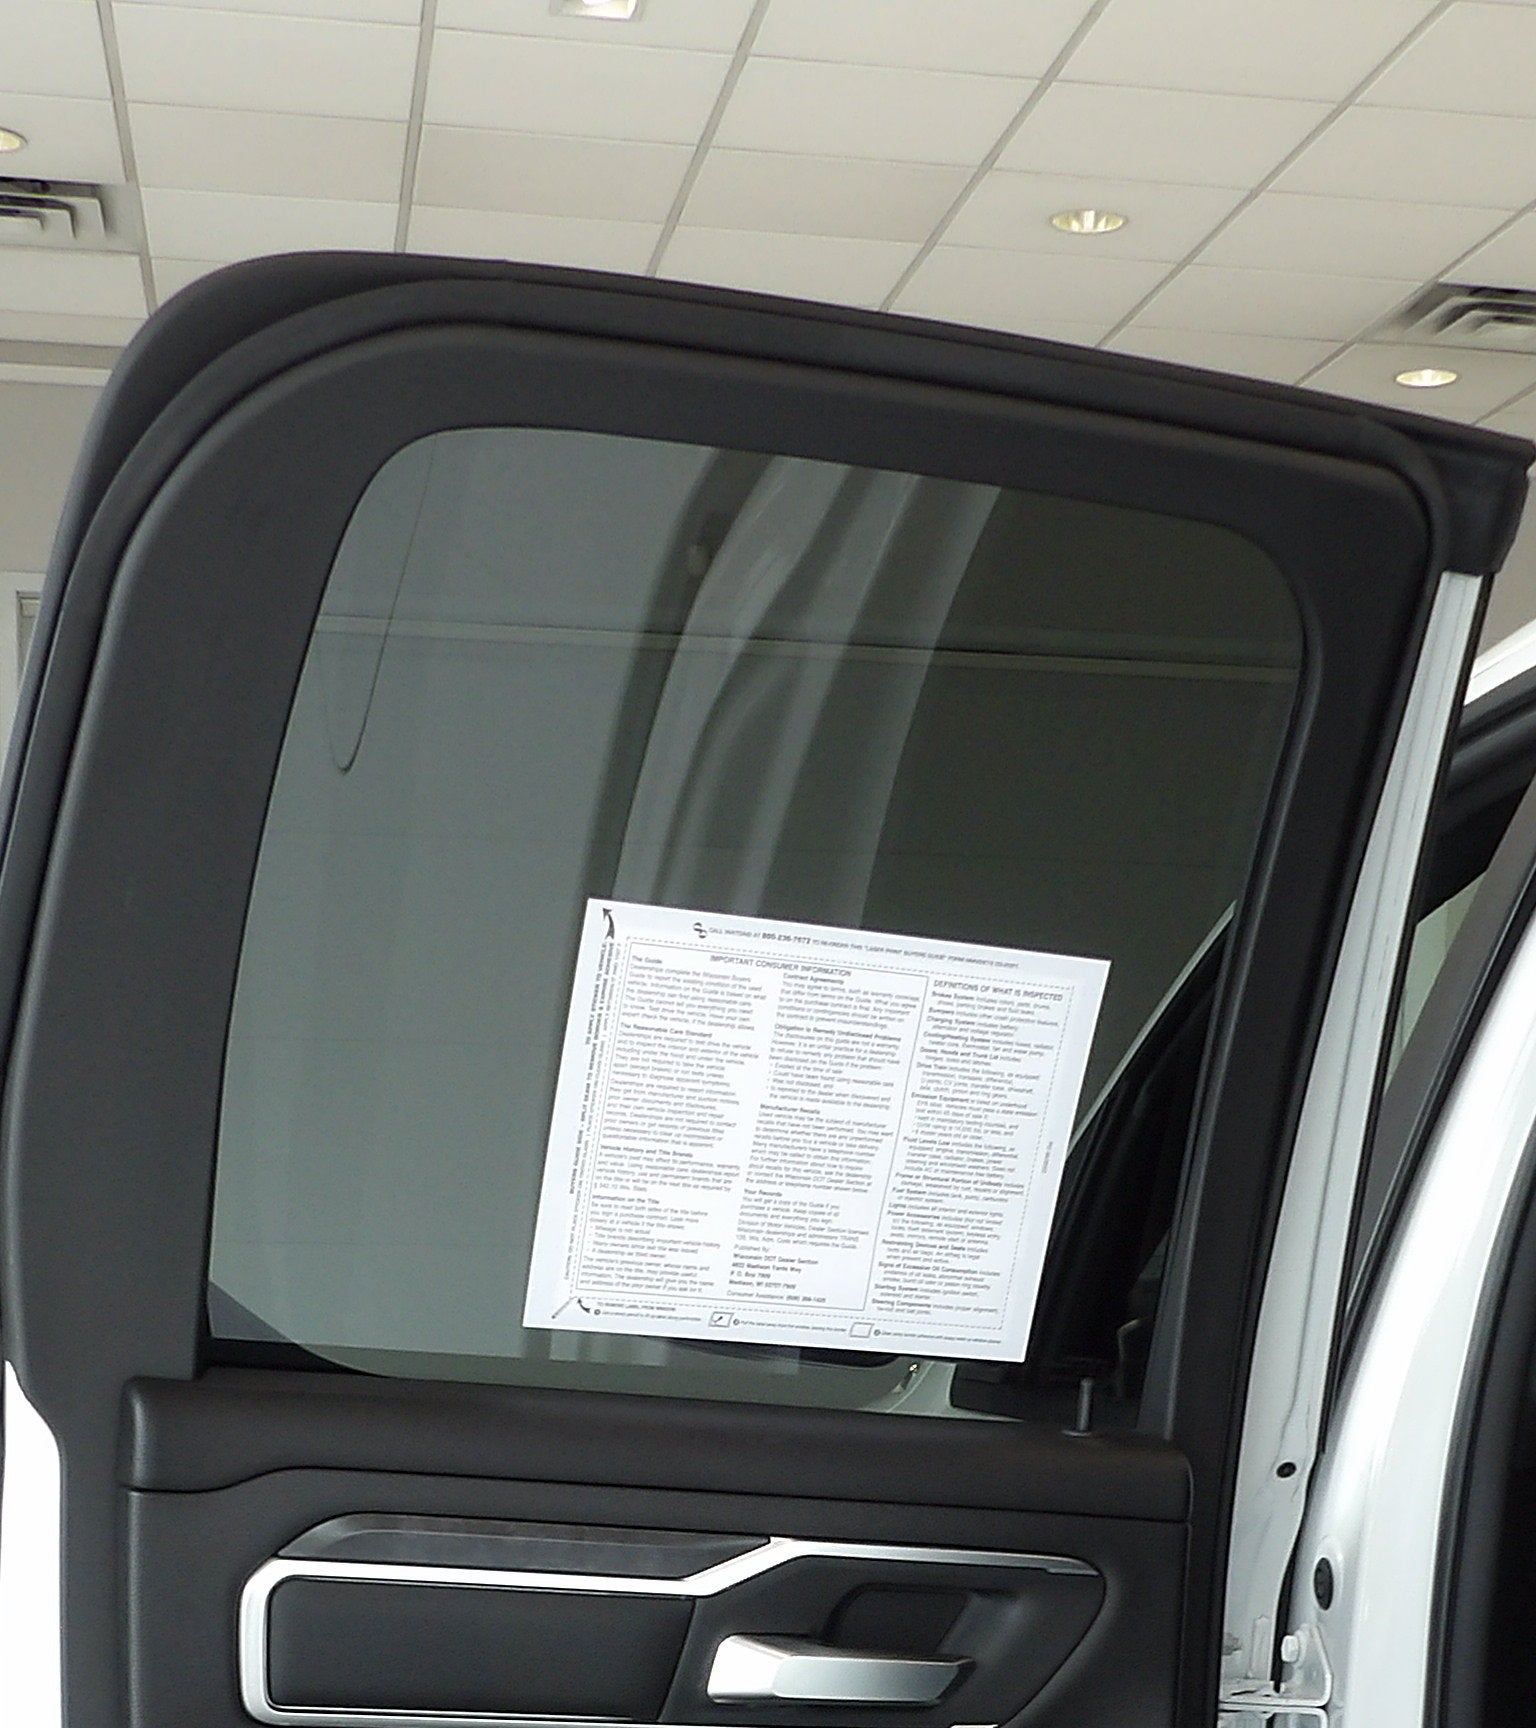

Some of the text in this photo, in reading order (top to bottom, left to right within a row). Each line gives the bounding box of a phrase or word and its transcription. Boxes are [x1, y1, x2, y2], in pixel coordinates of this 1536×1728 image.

[643, 956, 662, 964] Guide
[710, 954, 851, 977] IMPORTANT CONSUMER INFORMATION
[933, 980, 979, 991] DEFINITIONS
[991, 986, 1013, 995] WHAT
[1022, 990, 1063, 1001] INSPECTED
